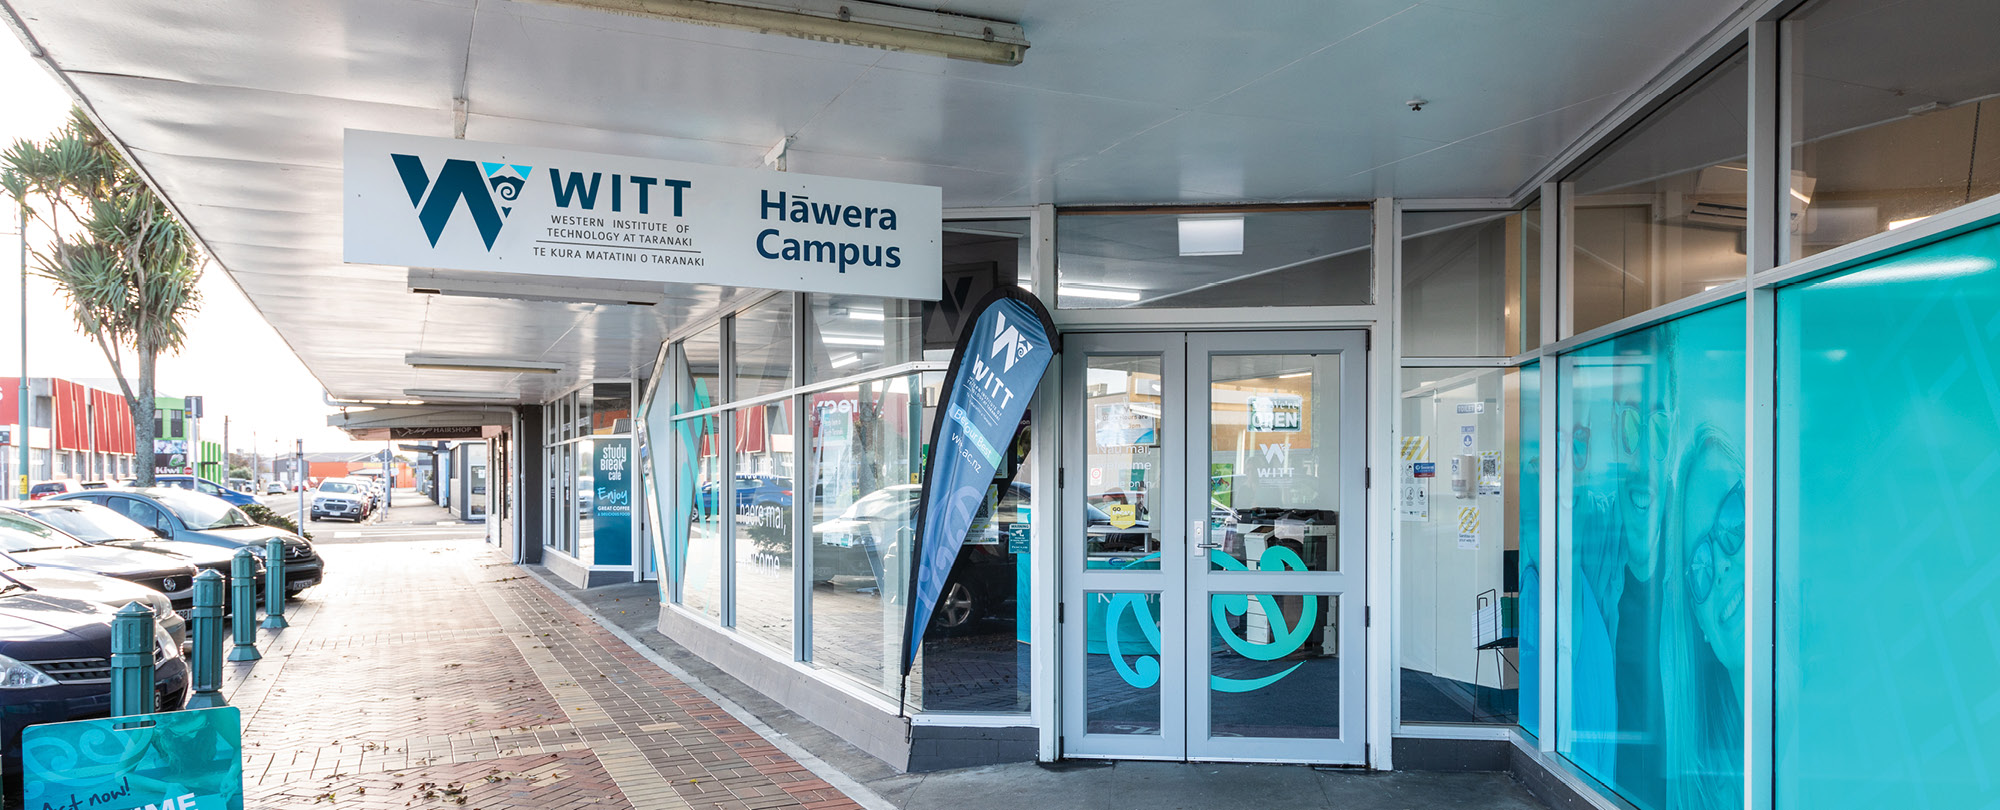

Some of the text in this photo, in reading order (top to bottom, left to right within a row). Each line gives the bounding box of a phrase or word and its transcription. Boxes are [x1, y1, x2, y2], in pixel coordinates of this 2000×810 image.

[549, 168, 692, 217] WITT
[761, 189, 897, 231] Hāwera
[551, 214, 690, 234] WESTERN INSTITUTE OF
[547, 227, 693, 247] TECHNOLOGY AT TARANAKI
[533, 246, 705, 267] TE KURA MATATINI O TARANAKI
[756, 228, 902, 273] Campus
[972, 354, 1014, 410] WITT
[1252, 411, 1298, 428] OPEN
[954, 408, 967, 423] Be
[976, 436, 993, 459] Best
[603, 444, 627, 463] study
[1096, 444, 1152, 456] Nau mai,
[600, 458, 624, 471] Break
[1257, 467, 1295, 478] WITT
[608, 470, 621, 480] cafe
[597, 486, 628, 506] Enjoy
[41, 776, 131, 810] Act now!
